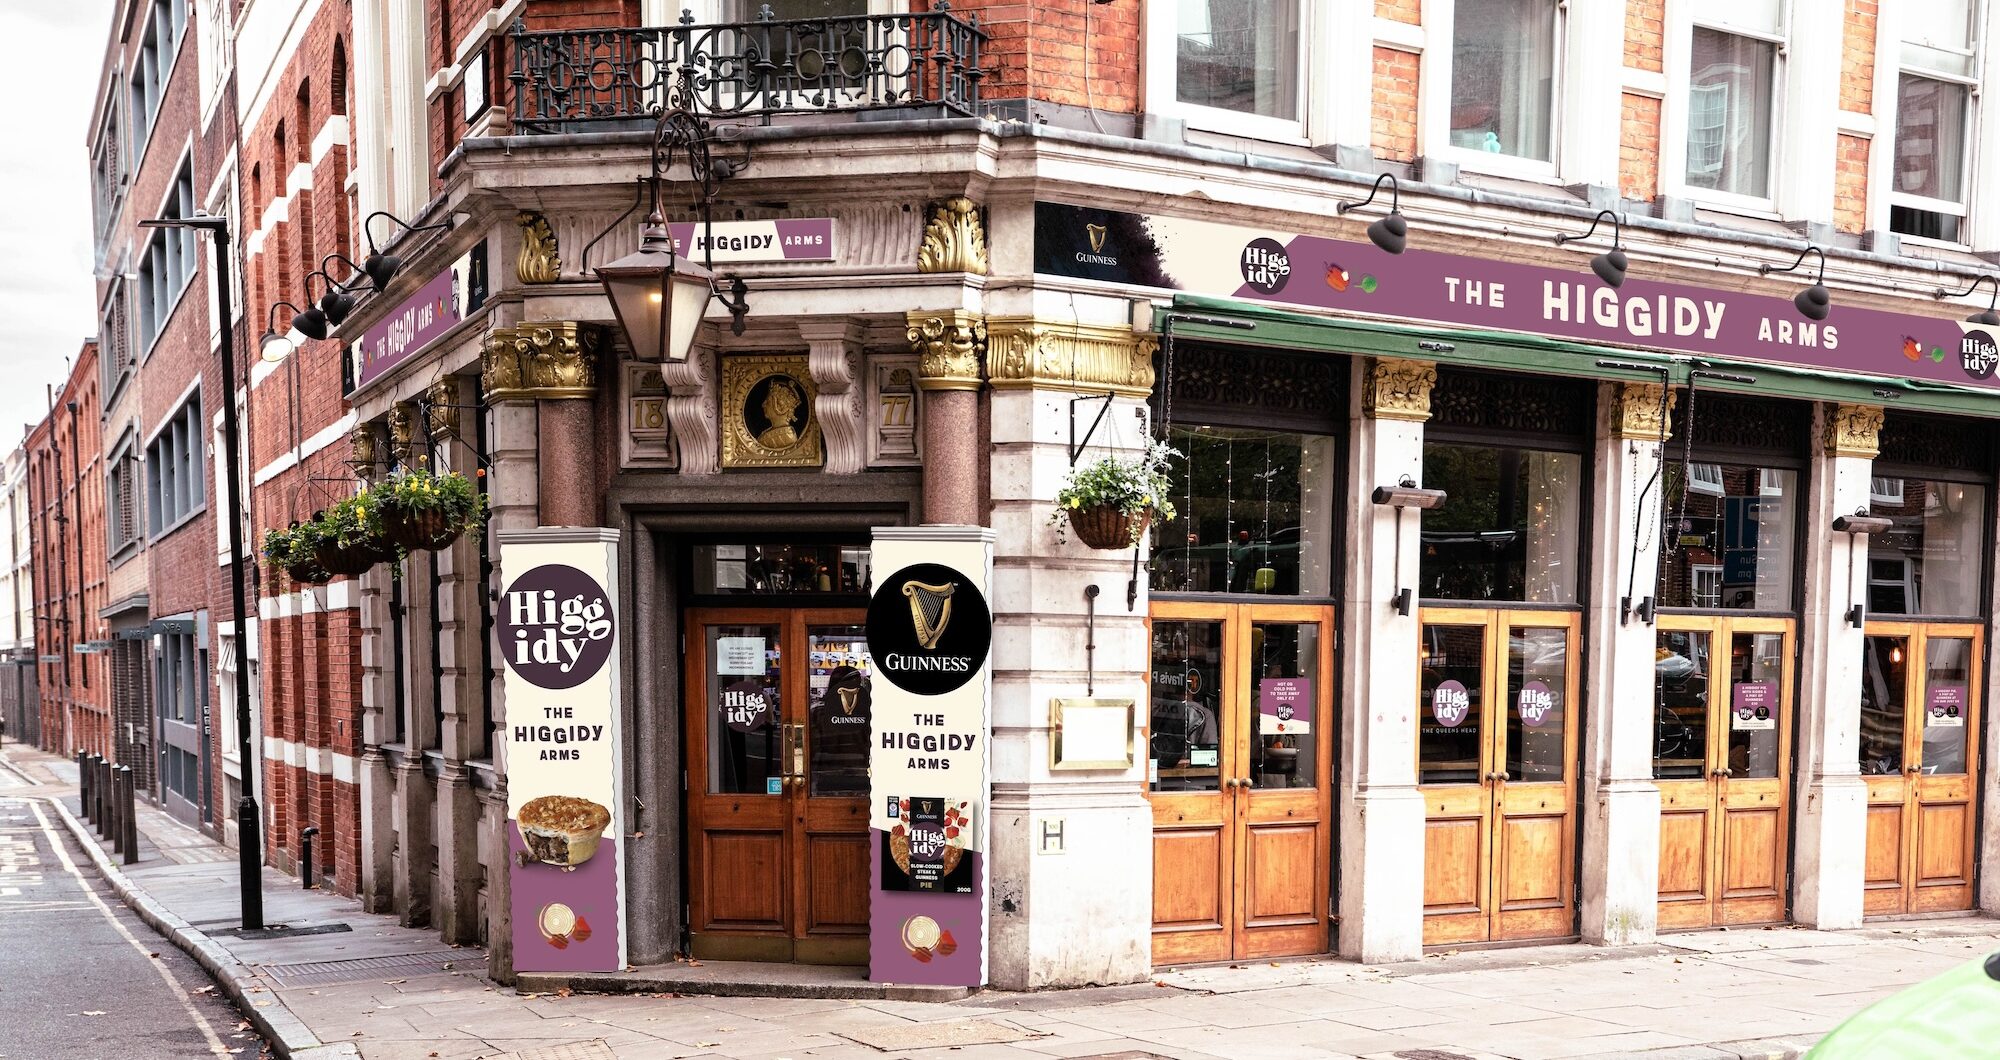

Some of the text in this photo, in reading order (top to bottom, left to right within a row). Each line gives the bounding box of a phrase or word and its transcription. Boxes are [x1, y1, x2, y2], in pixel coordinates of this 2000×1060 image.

[697, 234, 773, 251] HIGGIDY
[785, 235, 823, 246] ARMS
[1076, 251, 1117, 266] GUINNESS
[1245, 247, 1291, 276] Higg
[1247, 265, 1280, 288] idy
[1444, 276, 1839, 350] THE HIGGIDY ARMS
[377, 302, 433, 359] THE HIGGIDY ARMS
[1962, 339, 1998, 363] Higg
[1963, 354, 1991, 374] idy
[634, 399, 664, 429] 18
[882, 398, 911, 426] 77
[507, 589, 612, 641] Higg
[514, 628, 589, 673] idy
[885, 652, 969, 672] GUINNESS
[724, 691, 767, 712] Higg
[1436, 688, 1469, 710] Higg
[1520, 689, 1552, 710] Higg
[544, 707, 573, 718] THE
[727, 708, 758, 726] idy
[831, 716, 865, 724] GUINNESS
[914, 714, 944, 726] THE
[1437, 704, 1462, 722] idy
[1522, 704, 1545, 722] idy
[514, 725, 604, 744] HIGGIDY
[882, 732, 976, 752] HIGGIDY
[540, 750, 580, 760] ARMS
[908, 758, 950, 770] ARMS
[912, 830, 945, 847] Higg
[913, 842, 938, 857] idy
